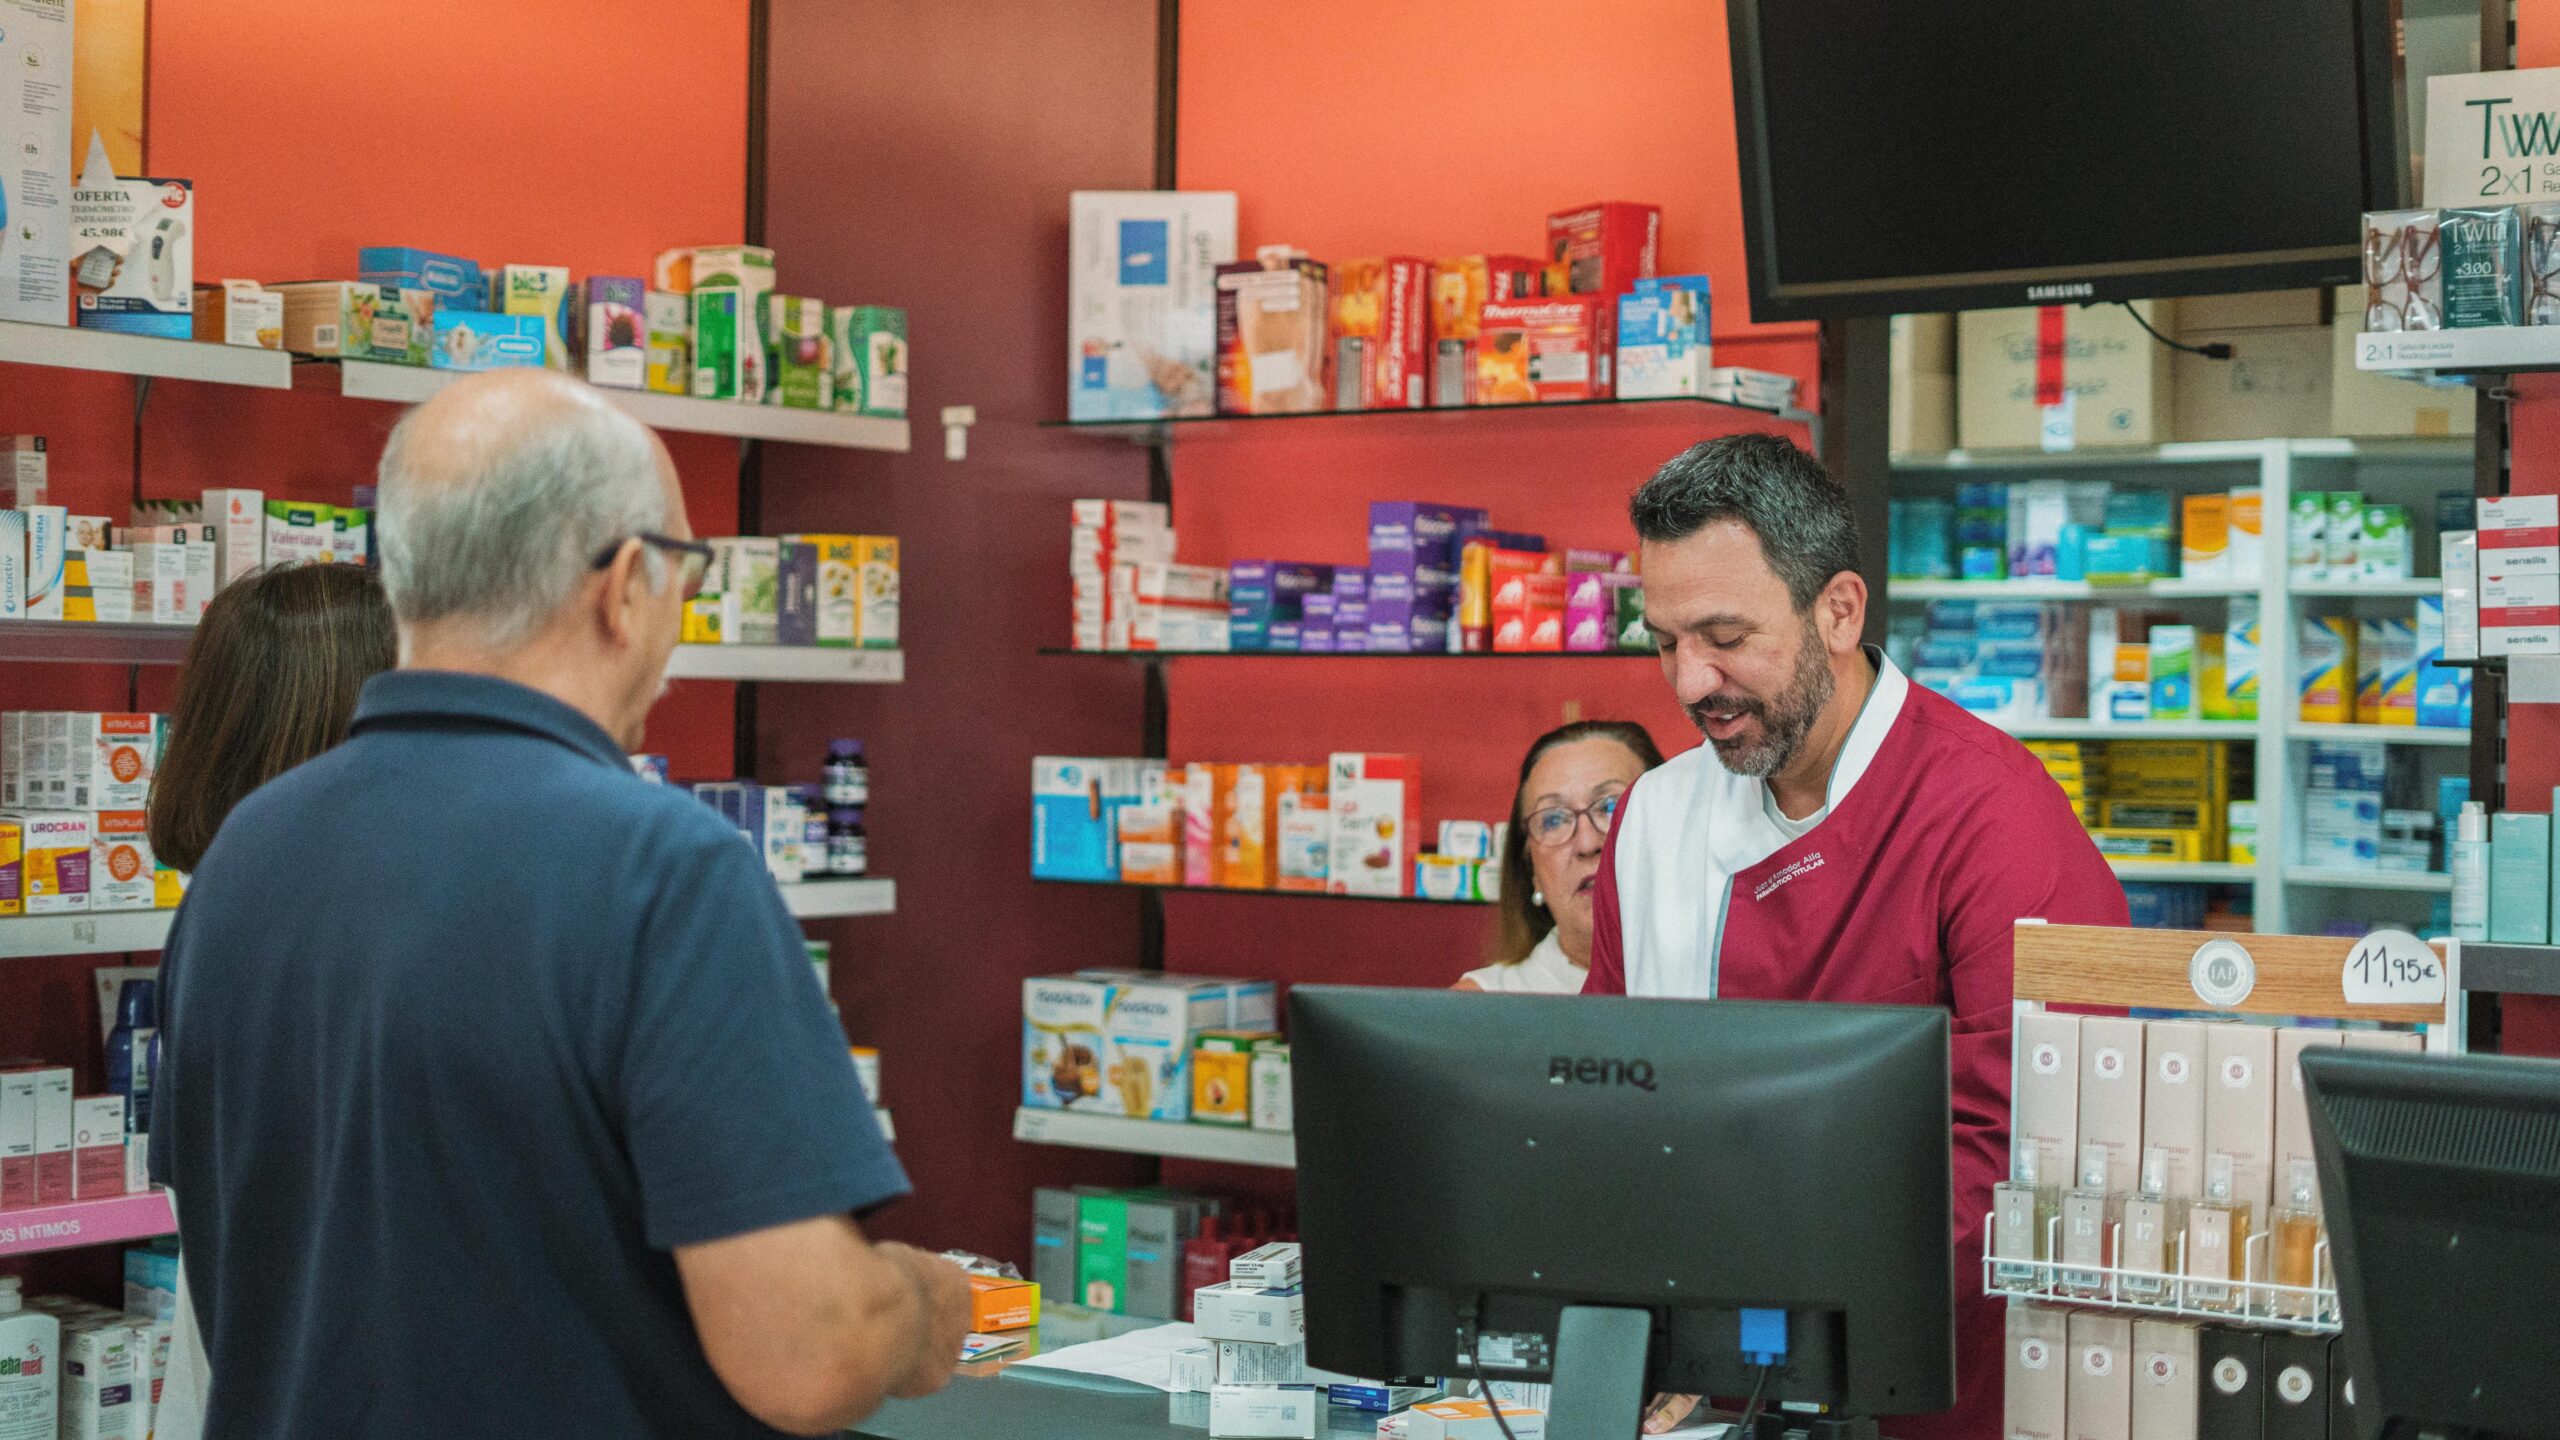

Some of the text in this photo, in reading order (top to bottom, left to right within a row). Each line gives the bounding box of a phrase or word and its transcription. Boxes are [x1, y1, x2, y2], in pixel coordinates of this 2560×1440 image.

[2480, 165, 2531, 196] 2x1
[73, 191, 131, 201] OFERTA
[2027, 283, 2094, 300] SAMSUNG
[2505, 556, 2547, 565] sensilis
[2506, 635, 2549, 643] sensilis
[31, 822, 86, 834] UROCRAN
[2211, 965, 2238, 980] IAP
[2353, 945, 2437, 988] 11,95€
[2009, 1210, 2021, 1227] 9
[18, 1219, 81, 1241] ÍNTIMOS
[2075, 1219, 2093, 1236] 15
[2135, 1221, 2154, 1240] 17
